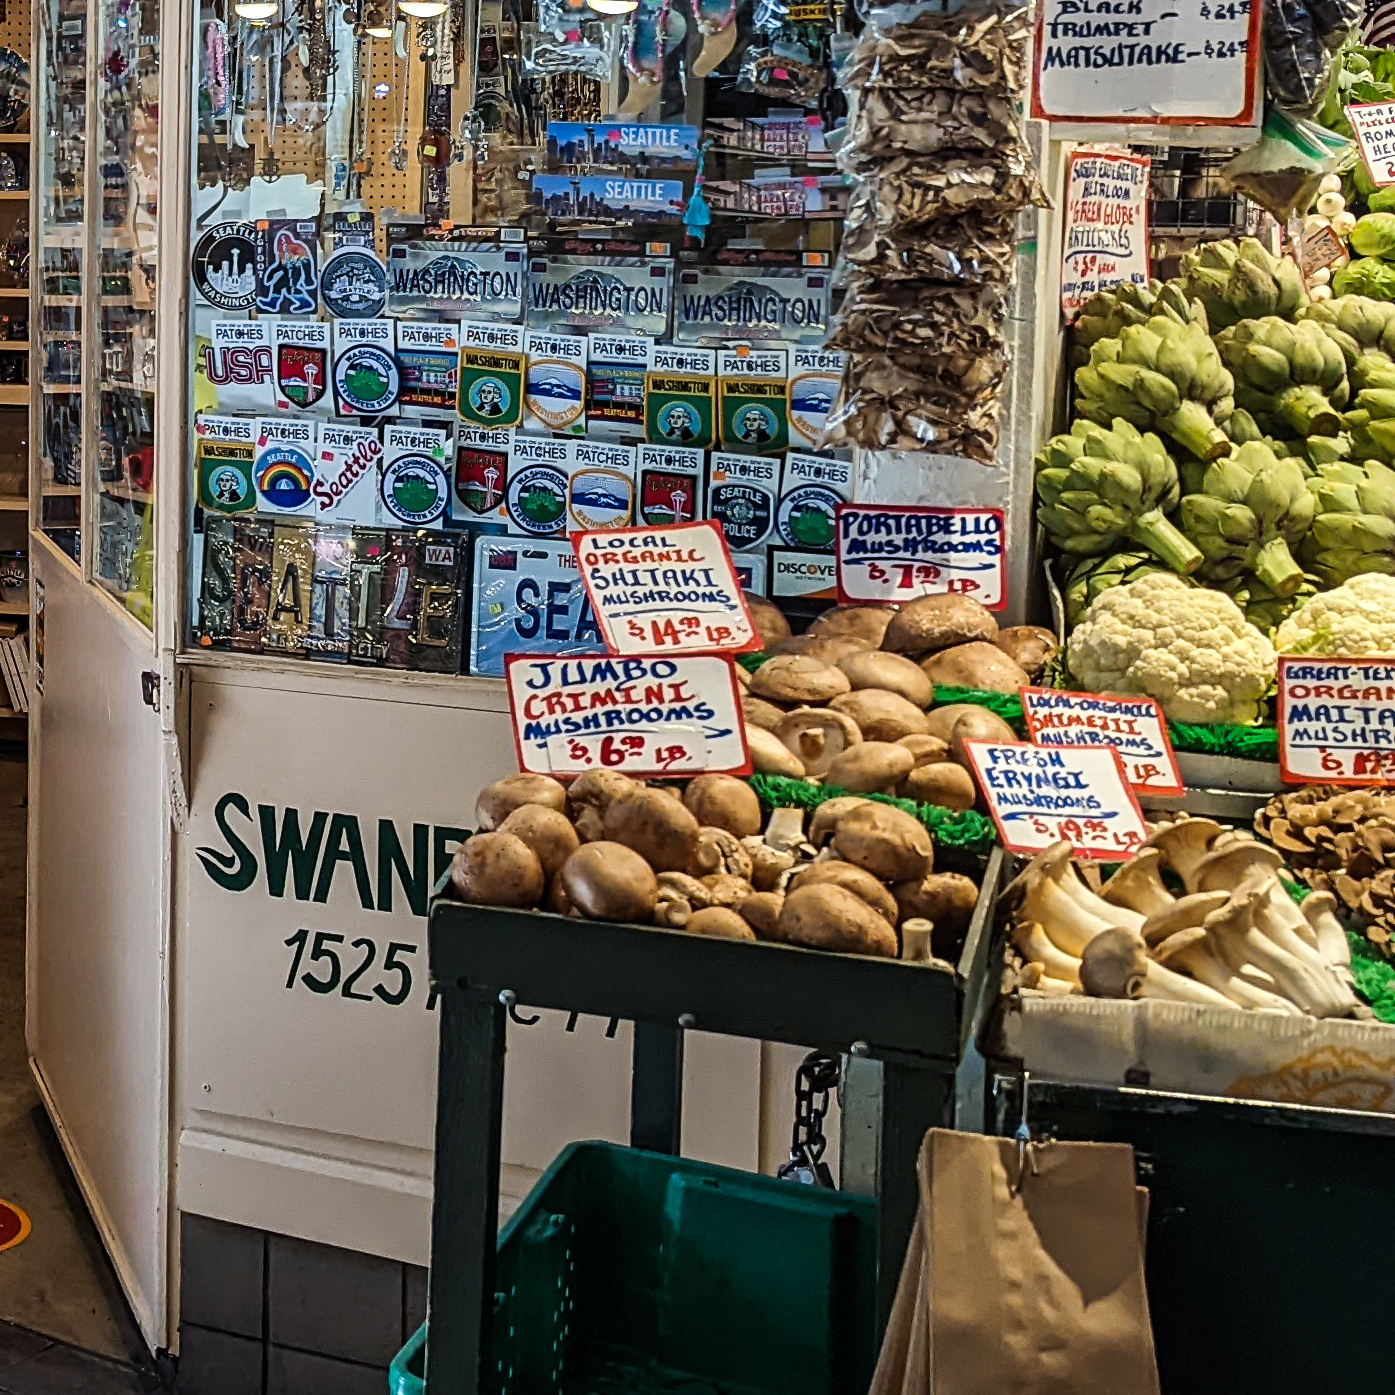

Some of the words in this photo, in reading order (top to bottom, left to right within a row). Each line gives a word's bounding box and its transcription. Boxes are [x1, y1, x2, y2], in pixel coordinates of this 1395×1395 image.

[1055, 0, 1143, 23] BLACK
[1046, 20, 1157, 39] TRUMPET
[1043, 42, 1185, 71] MATSUTAKE
[620, 128, 679, 147] SEATTLE
[605, 181, 664, 201] SEATTLE
[392, 269, 518, 297] WASHINGTON
[201, 282, 256, 307] WASHINGT
[532, 282, 664, 313] WASHINGTON
[682, 294, 822, 324] WASHINGTON
[216, 329, 263, 340] PATCHES
[276, 329, 325, 343] PATCHES
[339, 326, 389, 339] PATCHES
[402, 330, 452, 343] PATCHES
[466, 332, 518, 346] PATCHES
[529, 341, 582, 356] PATCHES
[593, 341, 647, 356] PATCHES
[205, 346, 274, 385] USA
[465, 357, 520, 371] WASHINGTON
[654, 357, 709, 371] PATCHES
[724, 359, 779, 373] PATCHES
[795, 355, 844, 367] PATCHE
[651, 378, 710, 394] WASHINGTON
[725, 381, 786, 396] WASHINGTON
[203, 425, 251, 439] PATCHES
[261, 427, 309, 440] PATCHES
[458, 429, 510, 444] PATCHES
[389, 434, 440, 449] PATCHES
[514, 445, 567, 461] PATCHES
[576, 449, 630, 466] PATCHES
[642, 454, 697, 468] PATCHES
[311, 438, 383, 511] Seattle
[717, 462, 773, 480] PATCHES
[791, 463, 848, 483] PATCHES
[720, 487, 762, 504] SEATTLE
[723, 522, 757, 538] POLICE
[839, 512, 1001, 539] PORTABELLO
[591, 536, 676, 550] LOCAL
[846, 537, 1001, 556] MUSHROOMS
[426, 548, 453, 563] WA
[585, 549, 705, 567] ORGANIC
[777, 562, 835, 576] DISCOVE
[591, 567, 719, 590] SHITAKI
[602, 590, 731, 606] MUSHROOMS
[525, 659, 677, 692] JUMBO
[523, 680, 696, 720] CRIMINI
[523, 702, 715, 740] MUSHROOMS
[1040, 729, 1154, 750] MUSHROOMS
[987, 748, 1065, 768] FRESH
[985, 767, 1090, 789] ERYNGI
[997, 791, 1101, 809] MUSHROOMS
[284, 928, 418, 1007] 1525
